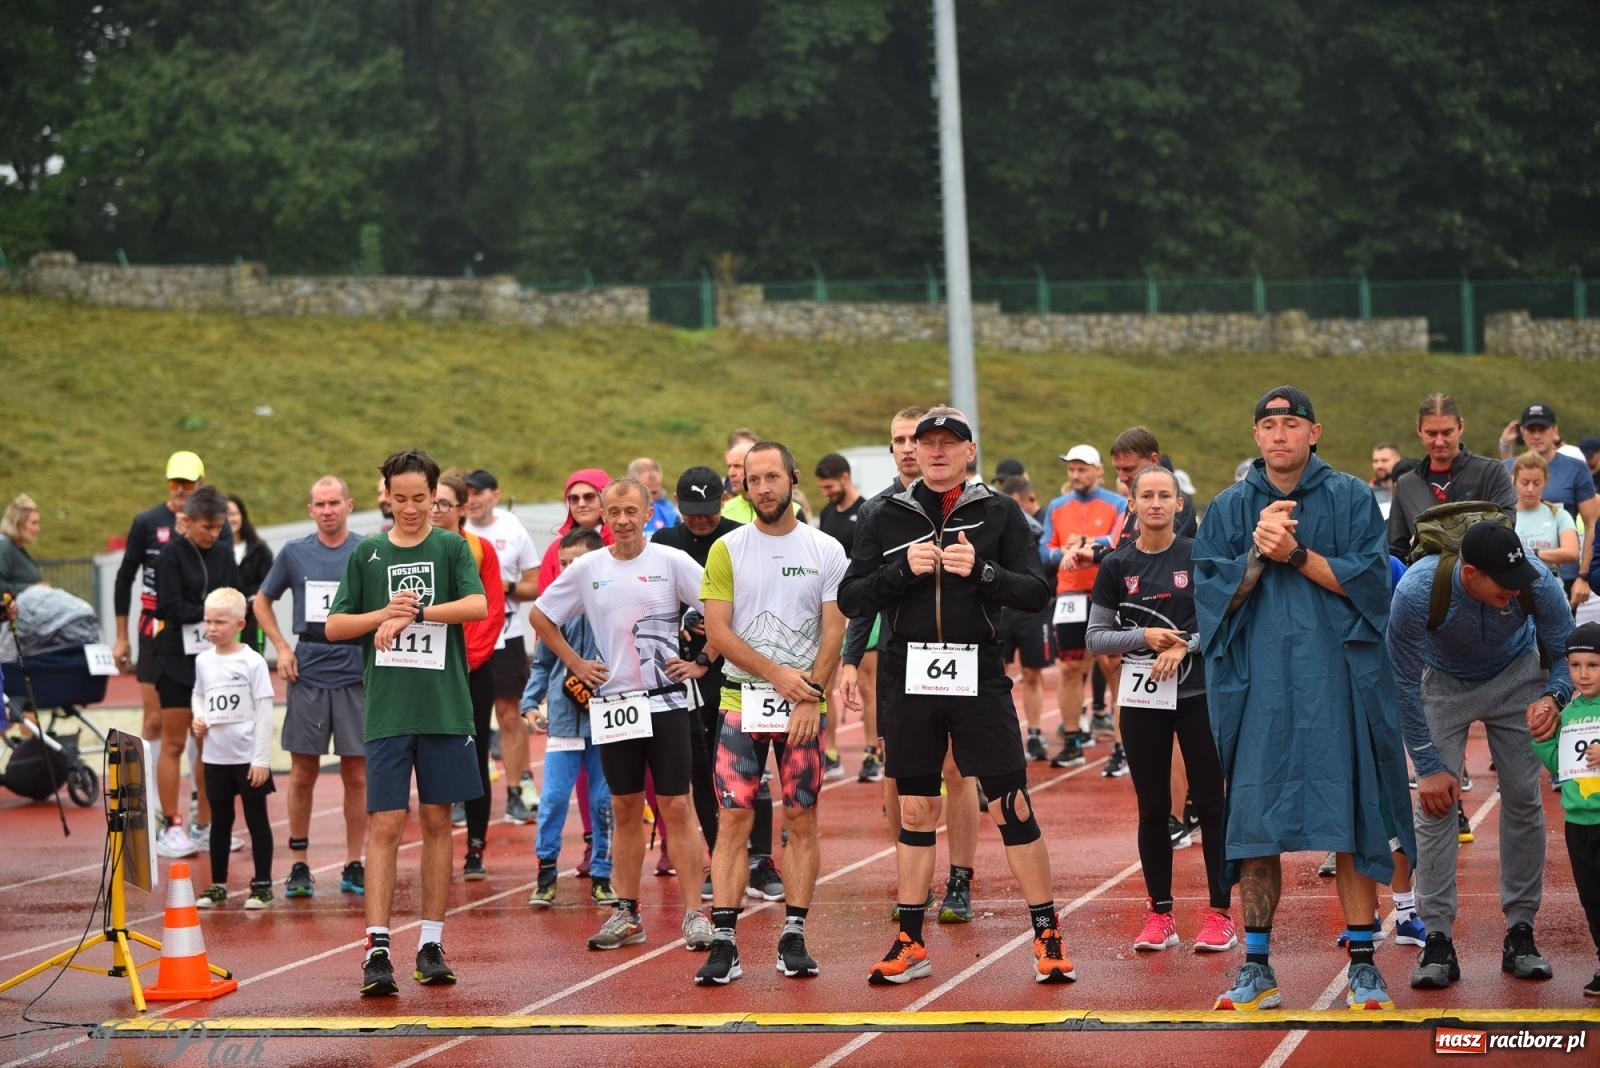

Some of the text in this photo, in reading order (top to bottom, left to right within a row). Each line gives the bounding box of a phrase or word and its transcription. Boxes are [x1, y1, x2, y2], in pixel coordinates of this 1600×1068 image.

[391, 565, 430, 577] KOSZALIN
[781, 565, 806, 577] UTA
[1059, 602, 1075, 614] 78
[391, 632, 433, 654] 111
[926, 658, 958, 680] 64
[564, 675, 592, 709] EAS
[1132, 672, 1158, 694] 76
[209, 694, 241, 712] 109
[761, 698, 792, 717] 54
[602, 705, 639, 729] 100
